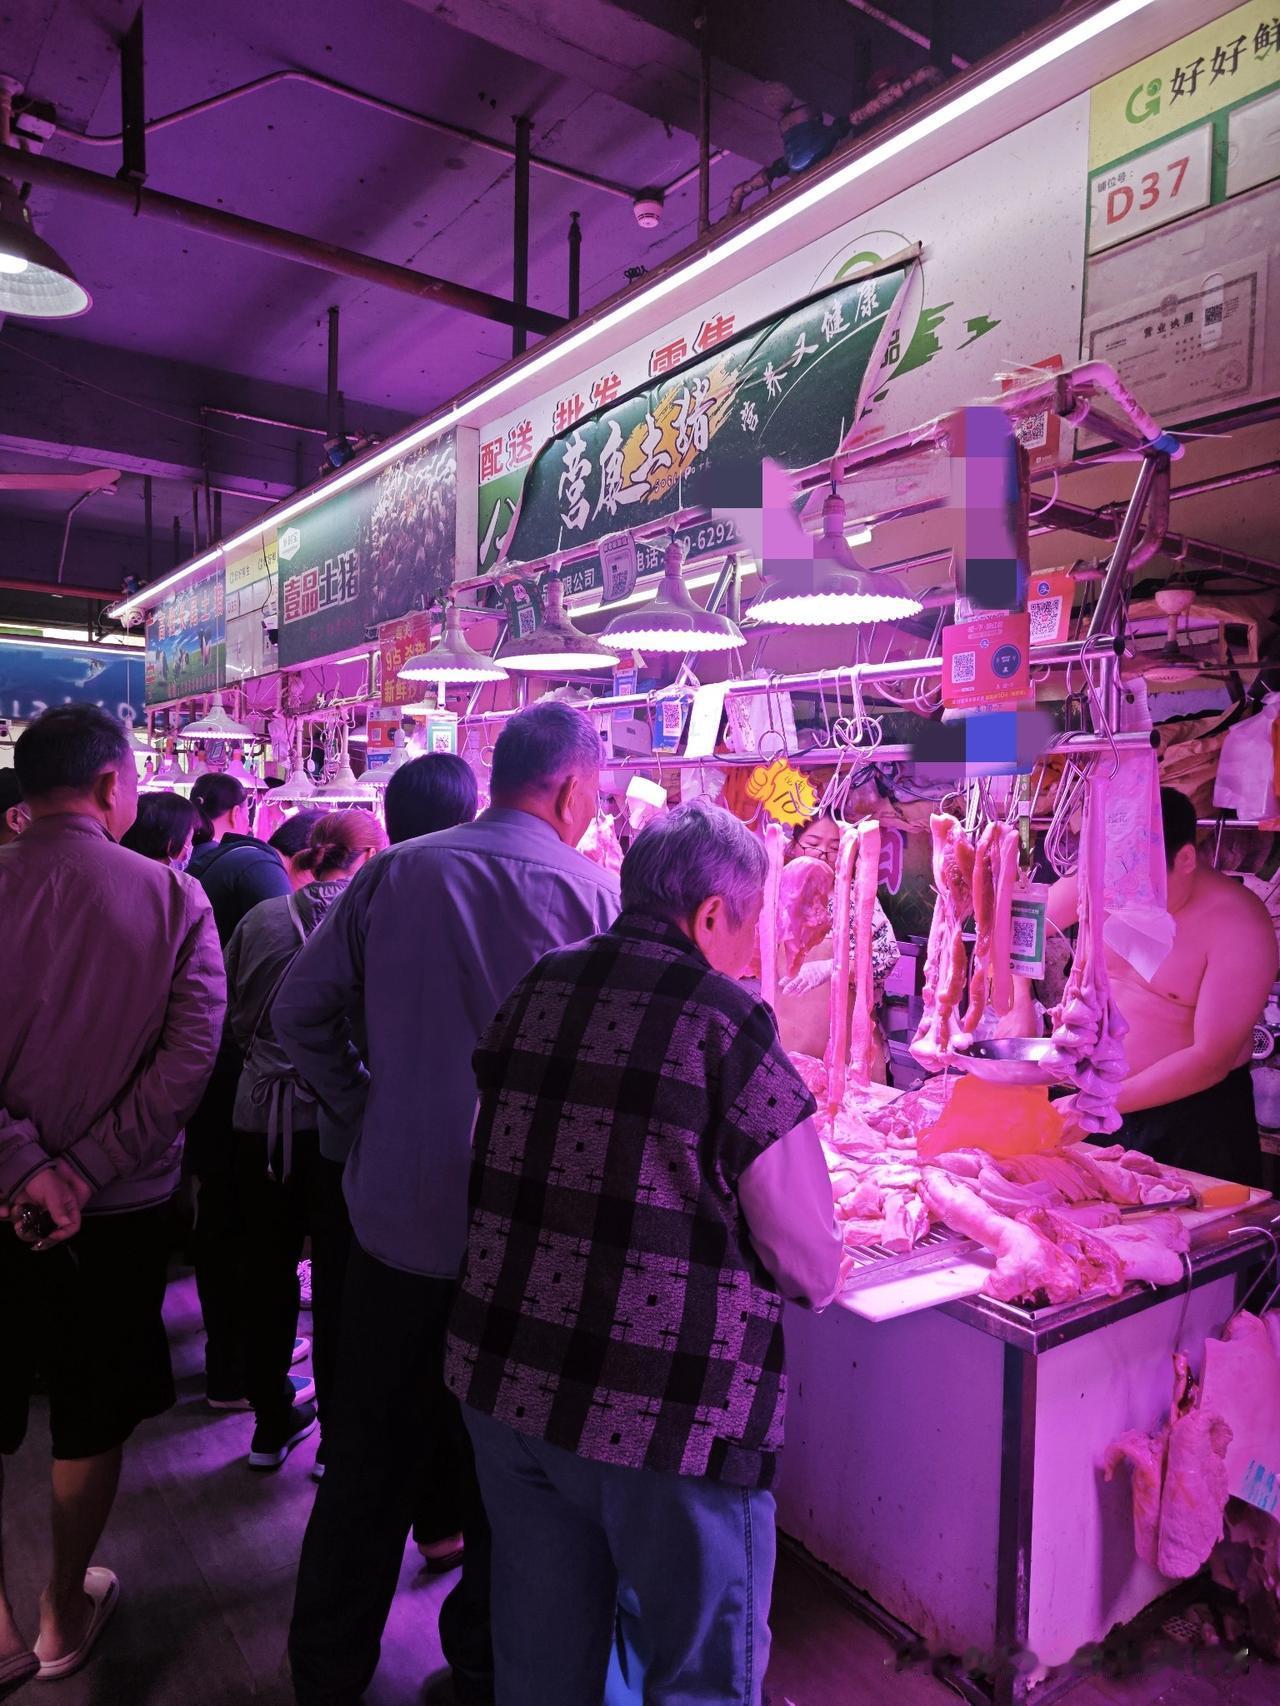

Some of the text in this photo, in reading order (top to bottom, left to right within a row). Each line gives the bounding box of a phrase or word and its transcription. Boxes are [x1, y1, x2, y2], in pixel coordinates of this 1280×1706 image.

[1106, 156, 1190, 225] D37
[480, 419, 534, 481] 配送
[284, 548, 361, 625] 壹品土猪
